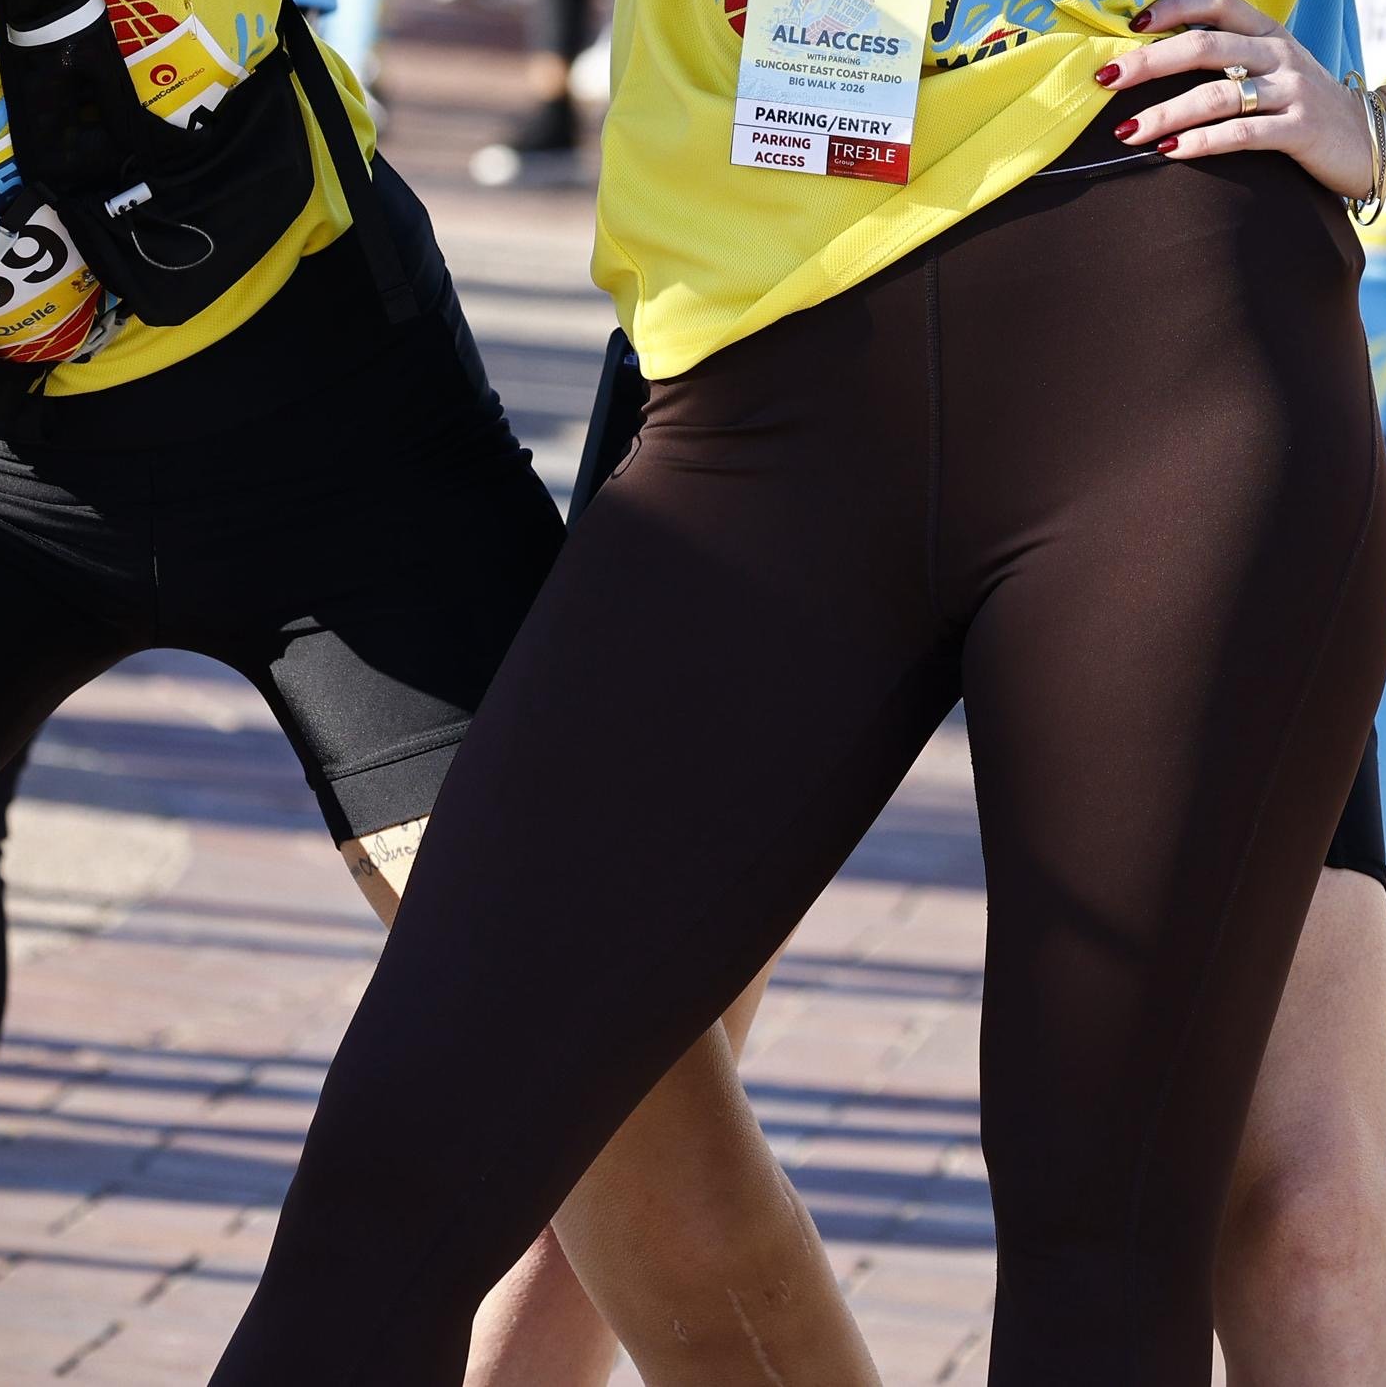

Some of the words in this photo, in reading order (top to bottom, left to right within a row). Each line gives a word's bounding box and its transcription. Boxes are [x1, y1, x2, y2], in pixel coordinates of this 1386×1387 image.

[772, 24, 811, 45] ALL
[816, 30, 900, 56] ACCESS
[806, 52, 827, 62] WITH
[828, 55, 861, 66] PARKING
[755, 59, 809, 74] SUNCOAST
[810, 65, 835, 76] EAST
[836, 68, 870, 81] COAST
[870, 72, 902, 84] RADIO
[789, 76, 805, 87] BIG
[807, 79, 836, 90] WALK
[840, 82, 865, 94] 2026
[755, 106, 892, 136] PARKING/ENTRY
[752, 132, 811, 150] PARKING
[754, 151, 806, 167] ACCESS
[834, 158, 855, 167] Group
